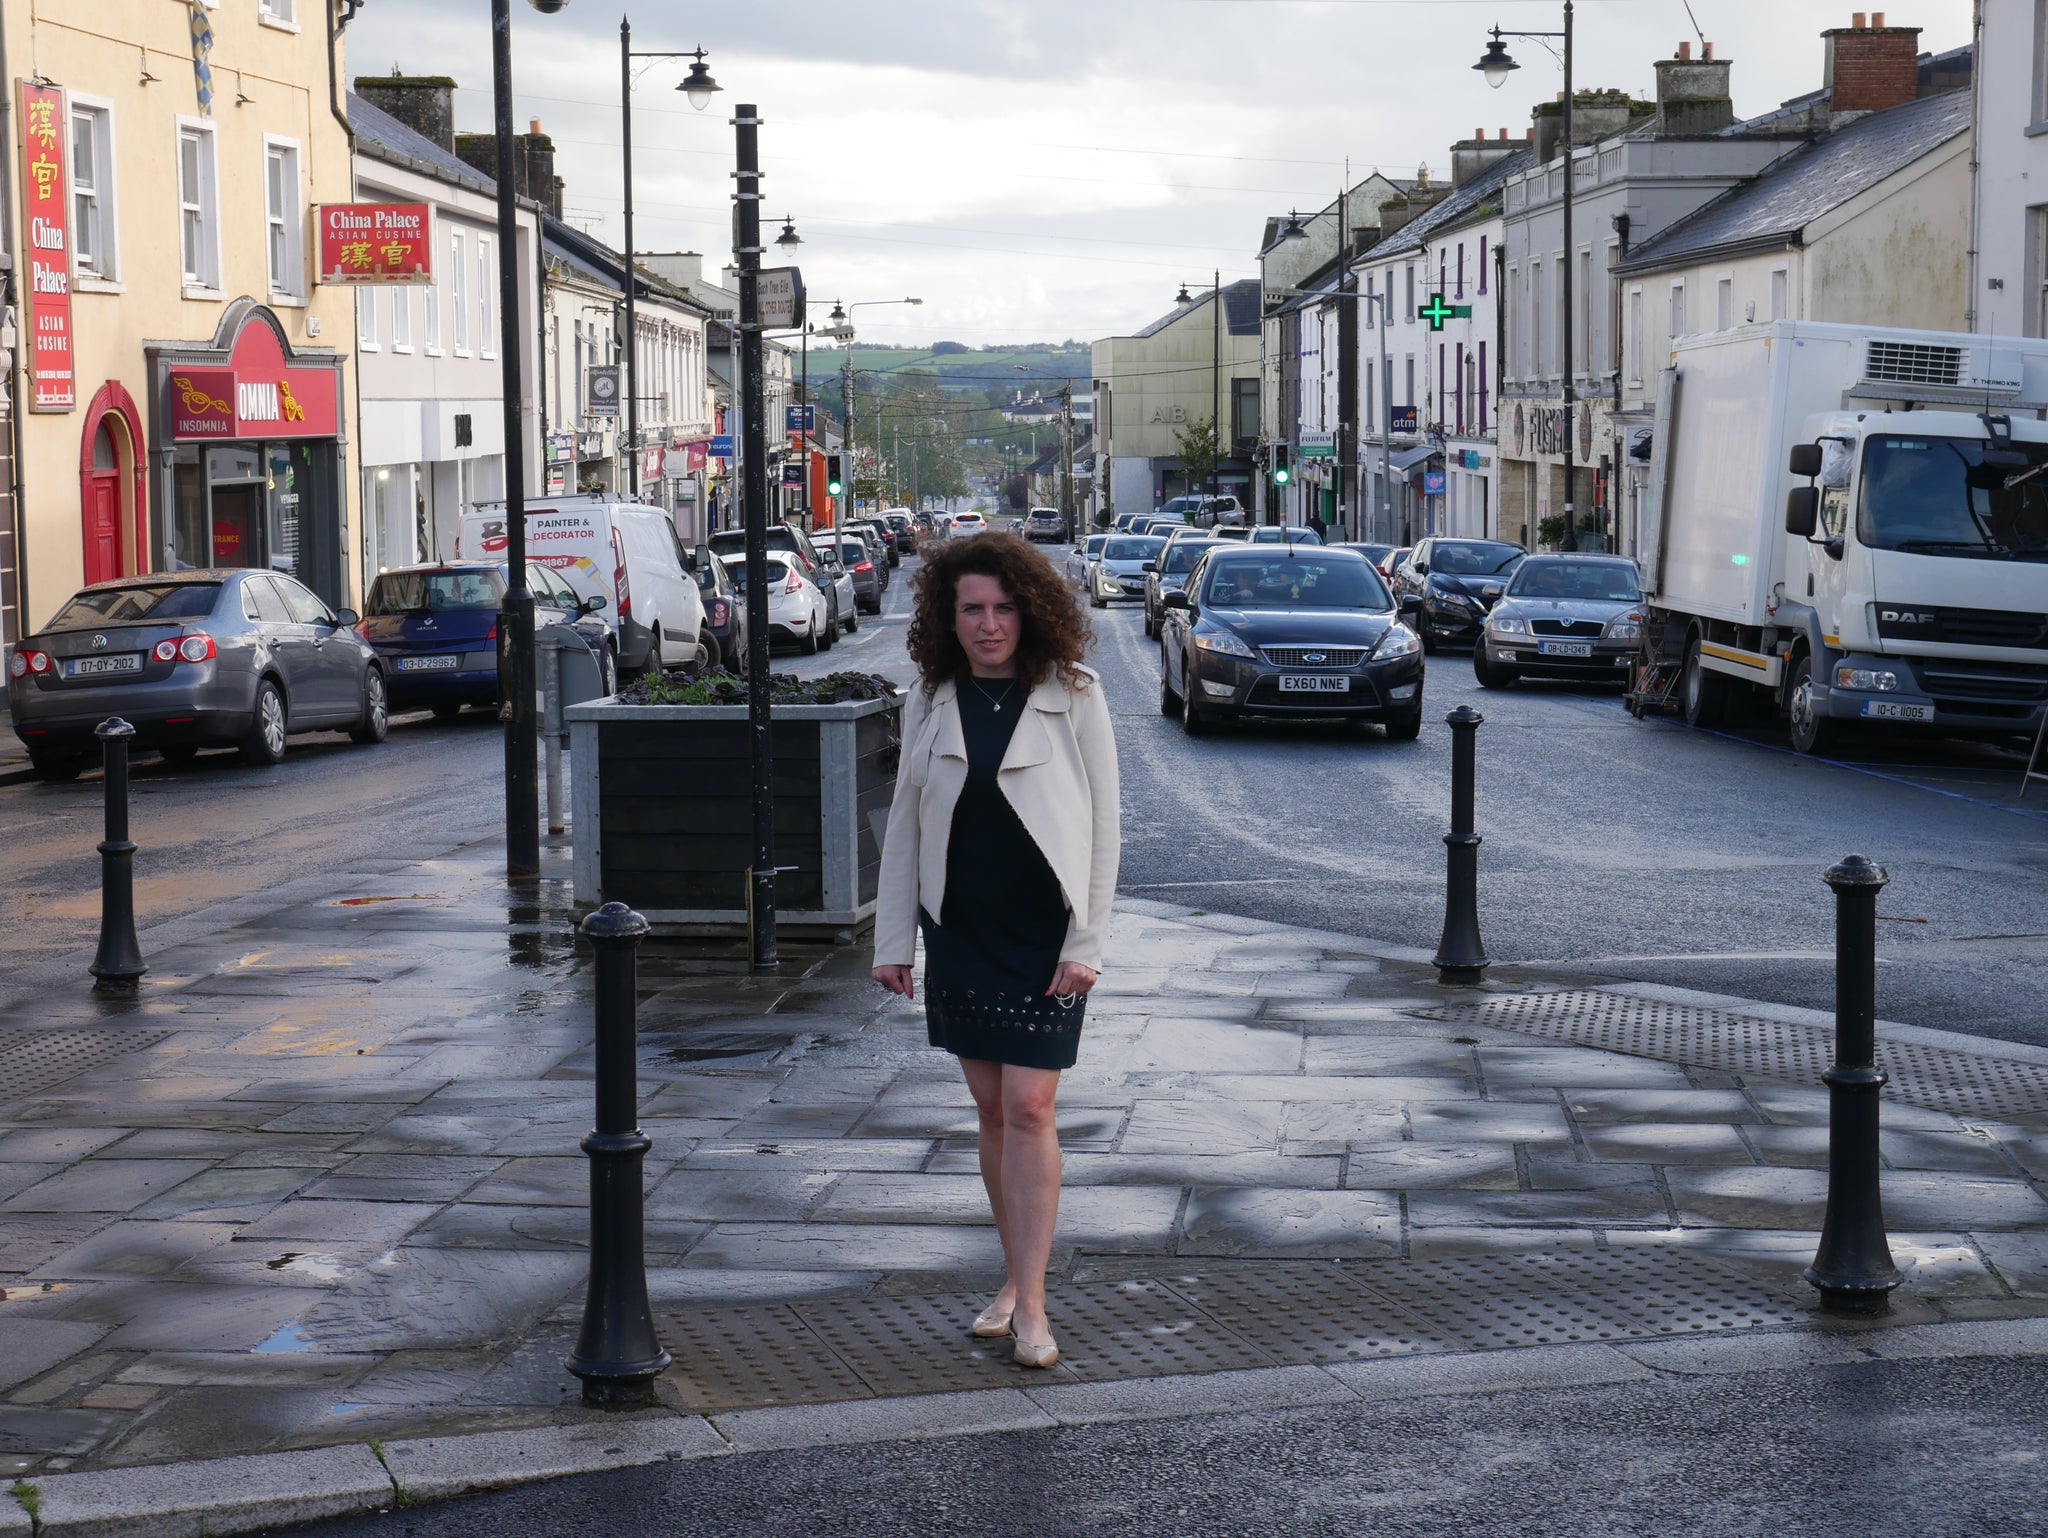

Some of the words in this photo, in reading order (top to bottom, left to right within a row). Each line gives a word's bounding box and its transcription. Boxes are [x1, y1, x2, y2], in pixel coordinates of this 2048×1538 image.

[330, 211, 372, 229] China
[374, 211, 420, 228] Palace
[32, 217, 63, 250] China
[329, 231, 367, 240] ASIAN
[376, 230, 421, 240] CUSINE
[32, 261, 67, 294] Palace
[39, 315, 64, 331] ASIAN
[37, 336, 67, 351] CUSINE
[239, 383, 279, 421] OMNIA
[1150, 405, 1186, 424] AIB
[179, 419, 228, 432] INSOMNIA
[1393, 418, 1415, 428] atm
[1529, 407, 1566, 455] FUSIO
[537, 518, 580, 529] PAINTER
[582, 518, 590, 527] &
[533, 530, 595, 541] DECORATOR
[1881, 610, 1935, 624] DAF
[80, 657, 134, 673] 07-OY-2102
[403, 657, 456, 670] 03-D-29962
[1284, 677, 1317, 690] EX60
[1320, 677, 1344, 690] NNE
[1877, 704, 1924, 718] 10-C11005
